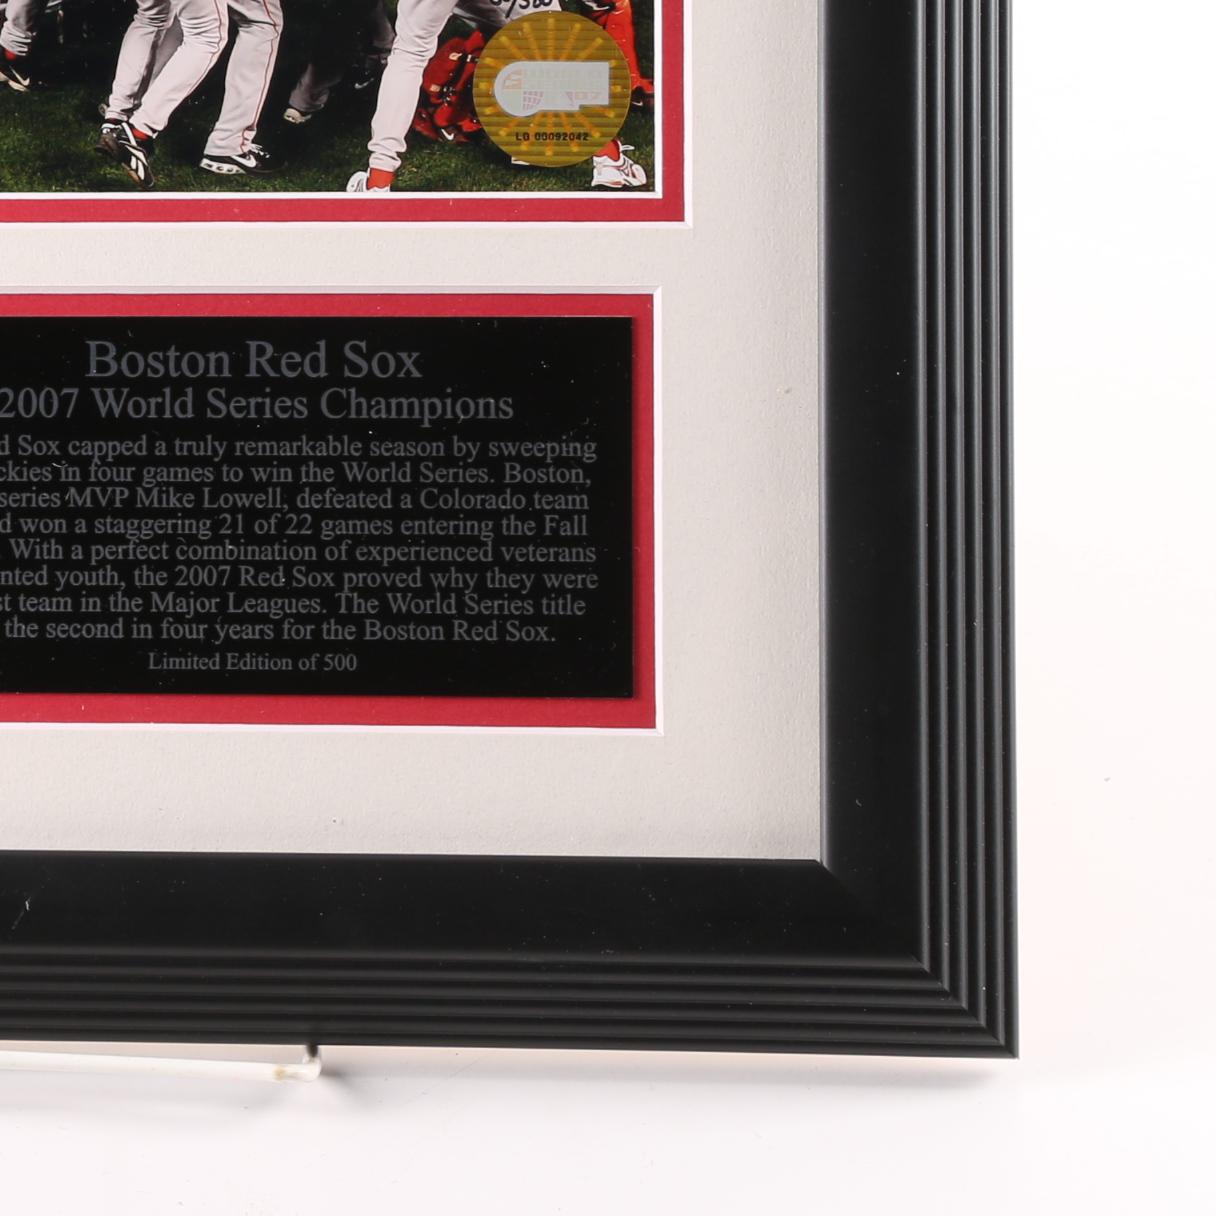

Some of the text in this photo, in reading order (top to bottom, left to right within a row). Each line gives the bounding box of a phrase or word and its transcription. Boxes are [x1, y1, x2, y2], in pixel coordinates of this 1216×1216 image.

[84, 339, 424, 380] Boston Red Sox
[90, 386, 195, 419] World
[206, 387, 309, 419] Series
[320, 387, 514, 428] Champions
[17, 433, 61, 456] Sox
[67, 433, 148, 462] capped
[154, 440, 168, 457] a
[174, 434, 228, 462] truly
[234, 434, 363, 457] remarkable
[369, 441, 445, 458] season
[453, 435, 481, 463] by
[488, 435, 598, 464] sweeping
[59, 459, 82, 482] in
[88, 459, 137, 482] four
[142, 466, 215, 488] games
[221, 460, 244, 483] to
[249, 460, 294, 483] win
[299, 460, 335, 483] the
[344, 460, 412, 484] World
[419, 461, 495, 484] Series.
[503, 461, 592, 487] Boston,
[68, 486, 130, 508] MVP
[135, 485, 196, 509] Mike
[202, 486, 289, 512] Lowell,
[296, 486, 393, 510] defeated
[399, 493, 413, 510] a
[419, 487, 527, 510] Colorado
[533, 487, 590, 510] team
[18, 517, 68, 534] won
[74, 518, 88, 534] a
[94, 511, 213, 540] staggering
[218, 512, 244, 535] 21
[253, 512, 281, 535] of
[284, 512, 313, 535] 22
[320, 519, 394, 541] games
[400, 513, 495, 541] entering
[501, 513, 537, 536] the
[543, 513, 588, 536] Fall
[11, 537, 64, 561] With
[70, 544, 84, 561] a
[90, 537, 169, 567] perfect
[175, 538, 318, 562] combination
[324, 538, 352, 562] of
[355, 538, 494, 569] experienced
[500, 539, 597, 563] veterans
[54, 564, 126, 593] youth,
[133, 564, 168, 588] the
[175, 565, 230, 588] 2007
[239, 565, 286, 588] Red
[292, 565, 335, 588] Sox
[343, 565, 423, 594] proved
[429, 566, 479, 594] why
[485, 566, 535, 595] they
[542, 573, 599, 590] were
[18, 590, 73, 613] team
[79, 590, 102, 613] in
[108, 590, 144, 613] the
[150, 590, 221, 619] Major
[226, 591, 327, 620] Leagues.
[335, 591, 380, 615] The
[388, 592, 457, 615] World
[464, 592, 534, 615] Series
[541, 592, 586, 615] title
[4, 616, 40, 639] the
[45, 616, 125, 639] second
[131, 616, 153, 639] in
[160, 617, 209, 640] four
[214, 623, 275, 645] years
[281, 617, 316, 640] for
[321, 617, 357, 640] the
[363, 617, 446, 641] Boston
[452, 618, 499, 641] Red
[505, 618, 556, 641] Sox.
[148, 651, 358, 671] Limited Edition of 500
